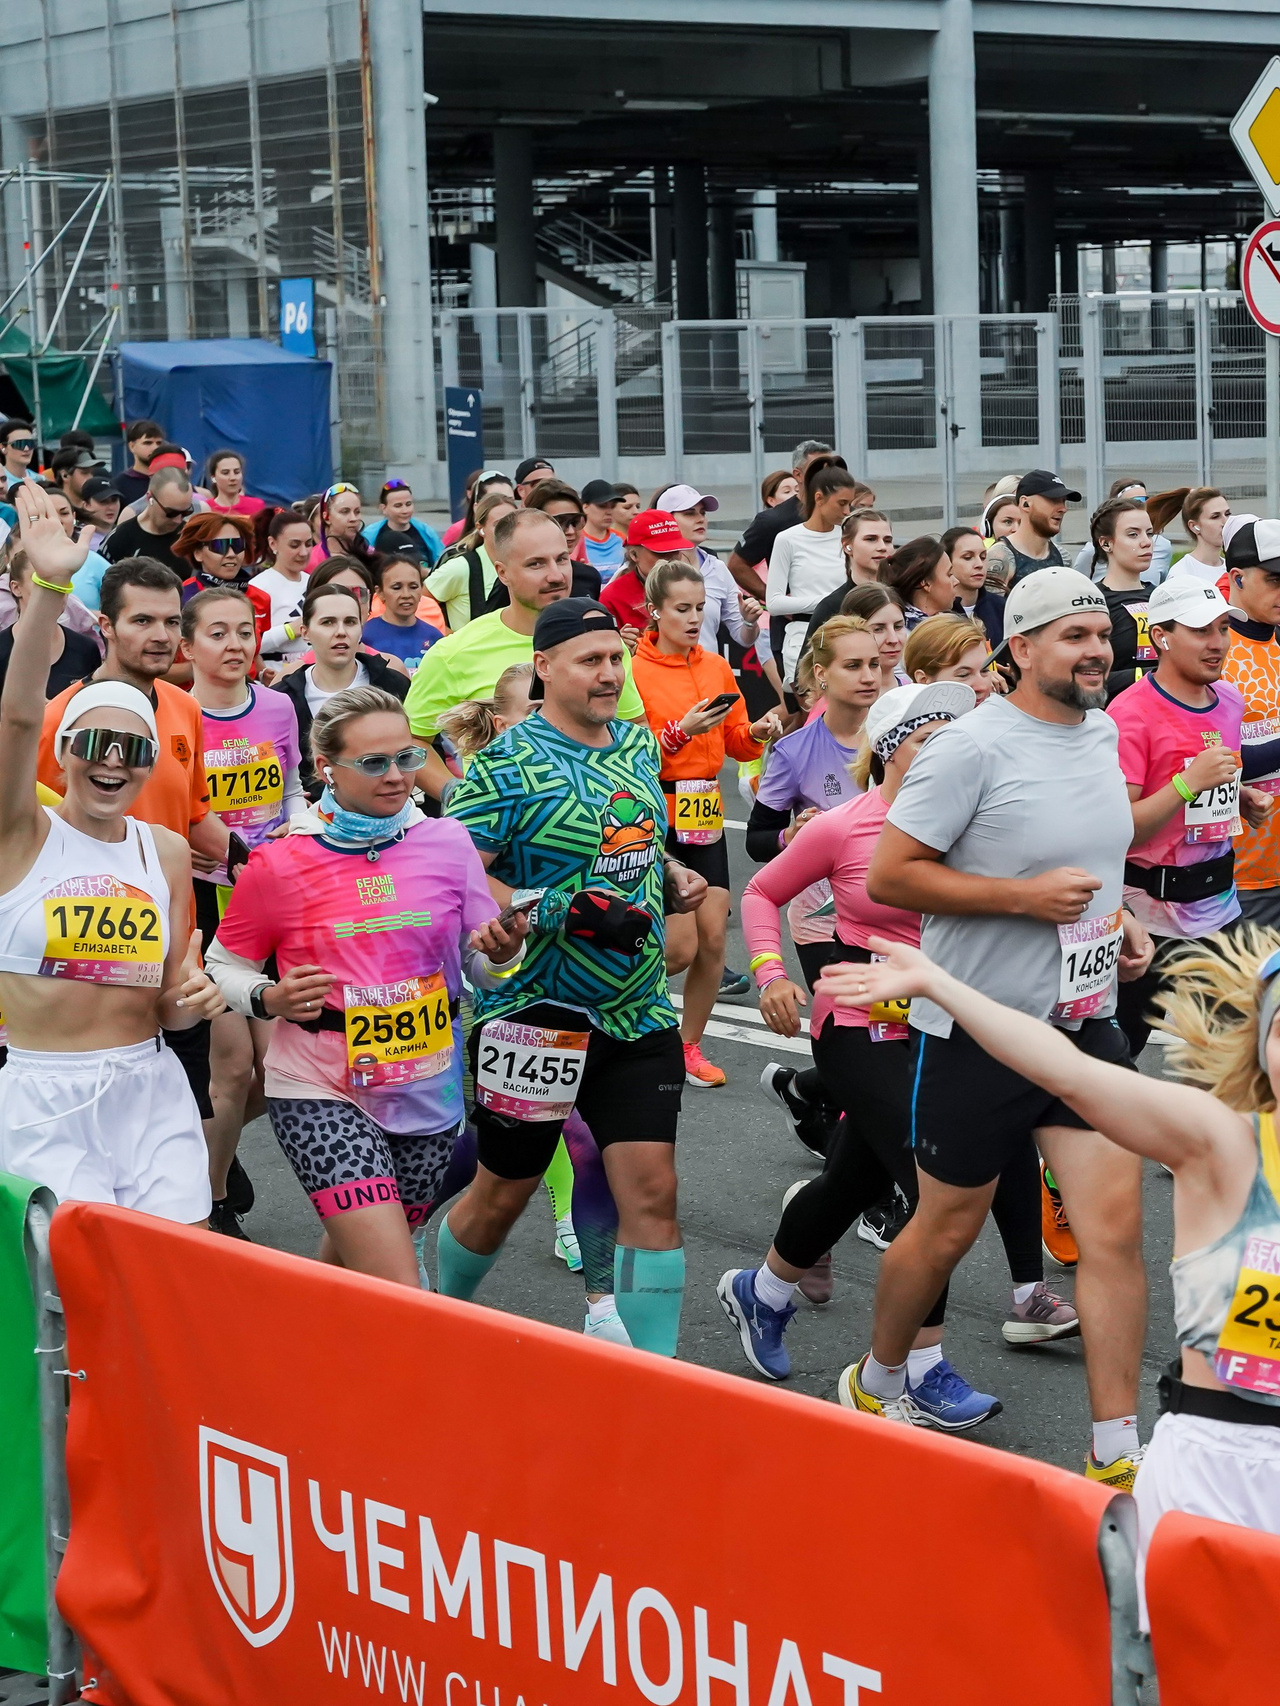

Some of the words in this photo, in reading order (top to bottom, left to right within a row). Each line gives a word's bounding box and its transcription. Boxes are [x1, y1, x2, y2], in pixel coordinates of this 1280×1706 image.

[285, 302, 308, 334] P6
[222, 738, 249, 747] БЕЛЫЕ
[207, 764, 281, 798] 17128
[230, 794, 263, 806] ЛЮБОВЬ
[1194, 827, 1203, 840] F
[594, 844, 656, 873] МЫТИЩИ
[356, 874, 394, 889] БЕЛЫЕ
[618, 868, 640, 882] БЕГУТ
[359, 884, 396, 899] НОЧИ
[361, 895, 397, 905] МАРАФОН
[53, 906, 159, 941] 17662
[73, 943, 138, 954] ЕЛИЗАВЕТА
[52, 961, 68, 976] F
[138, 963, 160, 973] 05.07
[136, 973, 160, 983] 2025
[345, 987, 384, 1001] БЕЛЫЕ
[385, 978, 420, 997] НОЧИ
[350, 998, 447, 1047] 25816
[522, 1028, 558, 1041] НОЧИ
[385, 1041, 428, 1056] КАРИНА
[481, 1045, 580, 1086] 21455
[503, 1081, 549, 1096] ВАСИЛИЙ
[483, 1091, 493, 1105] F
[1226, 1356, 1247, 1380] F
